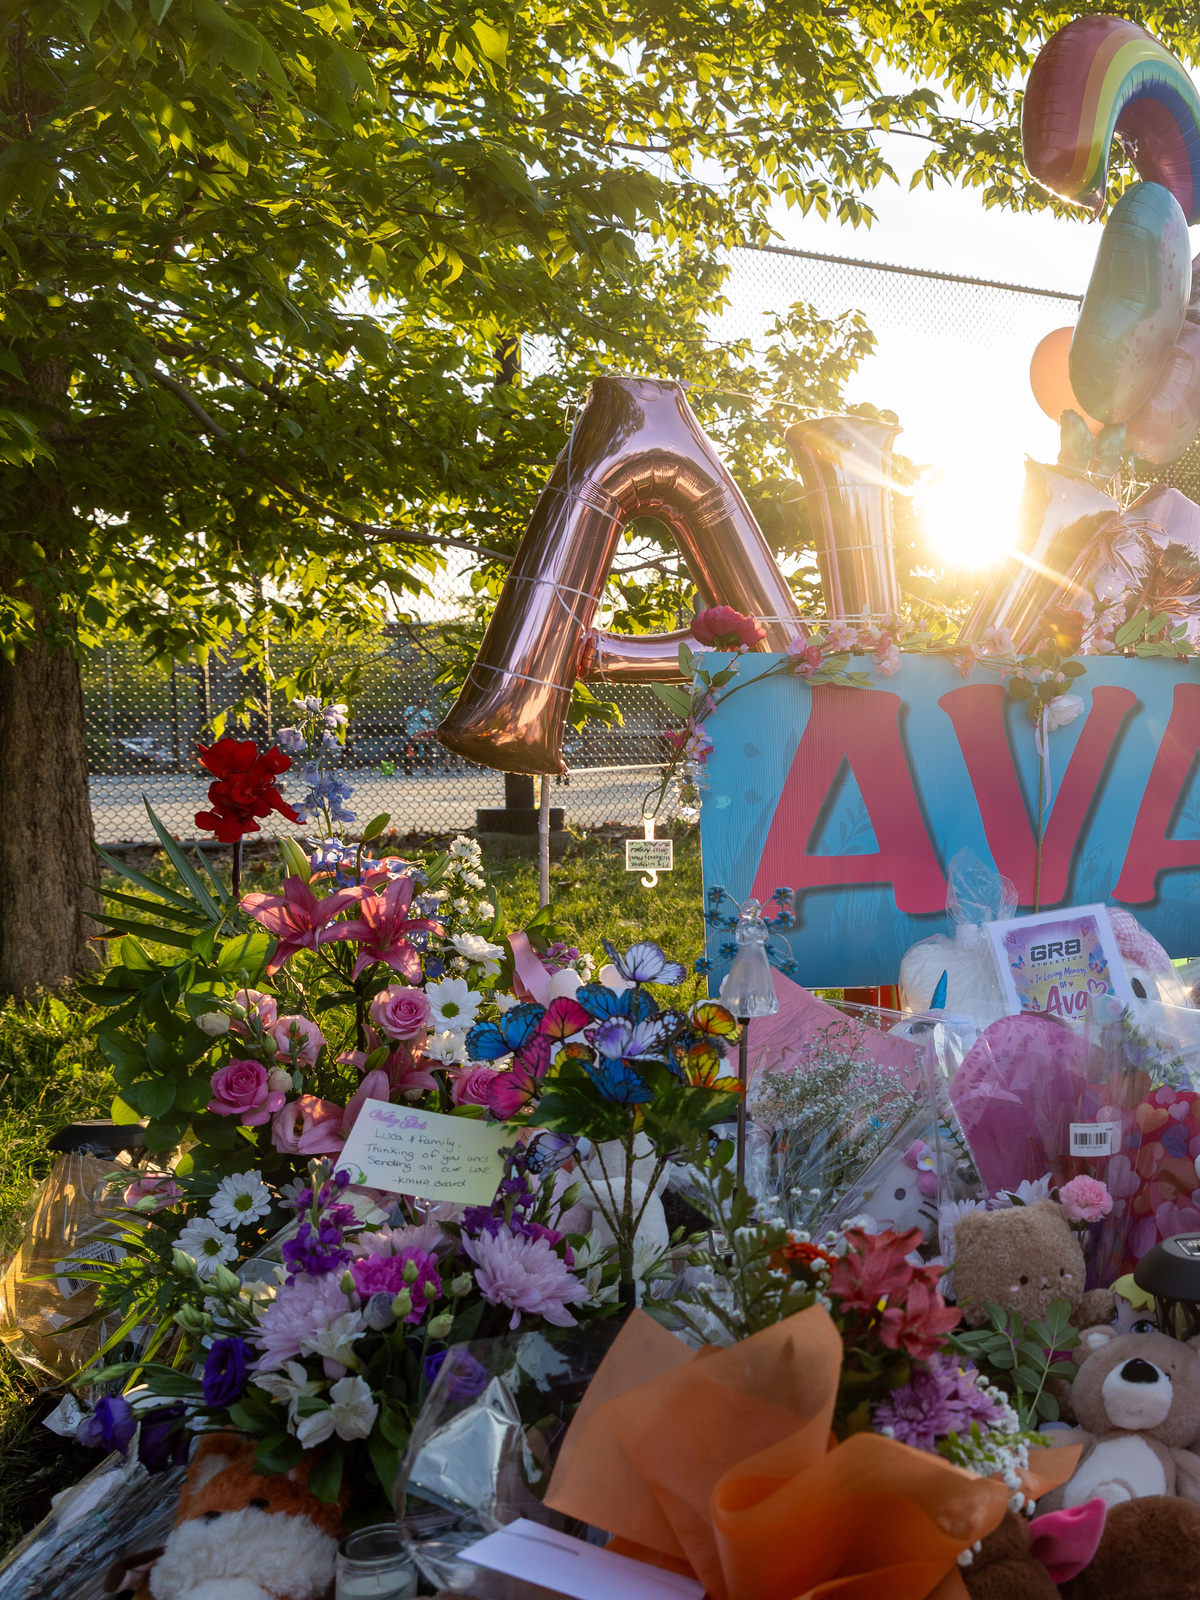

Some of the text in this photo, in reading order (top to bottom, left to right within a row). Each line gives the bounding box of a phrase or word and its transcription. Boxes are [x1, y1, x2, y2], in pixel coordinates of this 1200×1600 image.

[1031, 939, 1081, 962] GR8
[1031, 955, 1084, 968] ATHLETICS
[1035, 966, 1087, 984] In Loving Memory
[1060, 980, 1067, 988] OF
[1045, 985, 1089, 1016] Ava
[363, 1144, 489, 1166] Thinking of you and
[367, 1156, 412, 1173] Sending
